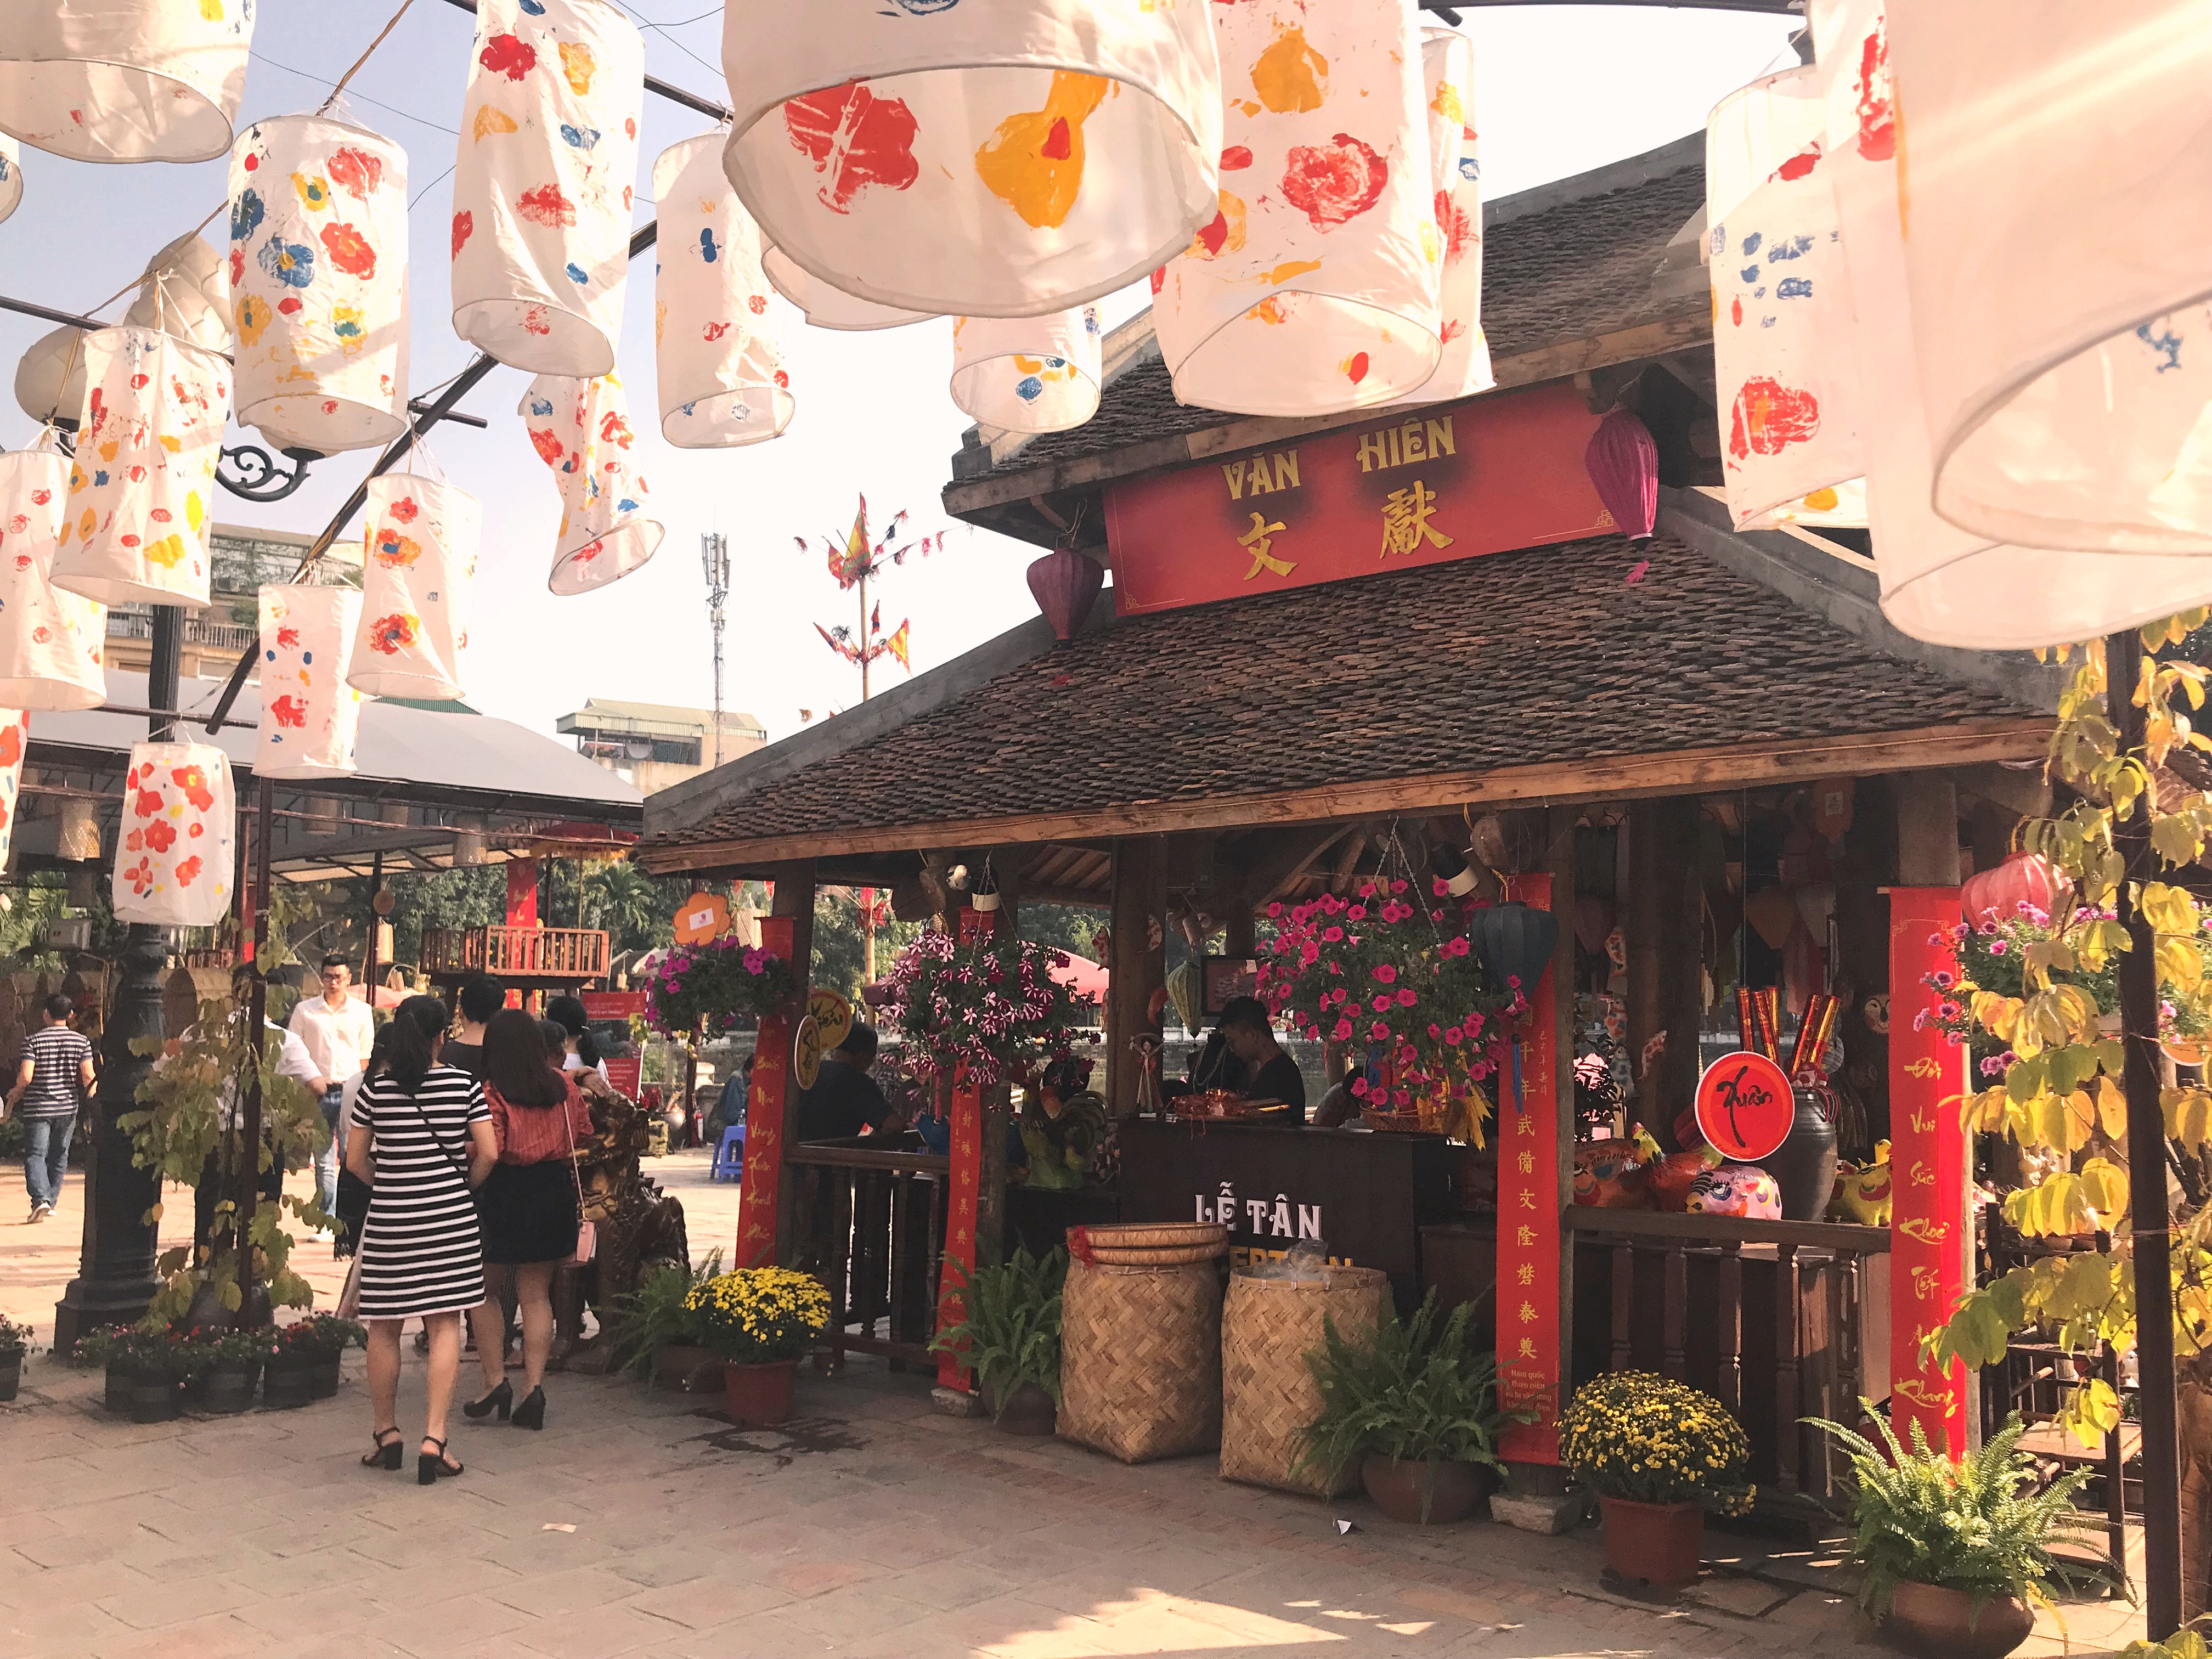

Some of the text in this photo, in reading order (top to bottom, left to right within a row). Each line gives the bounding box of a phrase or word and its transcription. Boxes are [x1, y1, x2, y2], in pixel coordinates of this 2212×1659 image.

[1221, 450, 1301, 500] VĂN
[1237, 512, 1299, 581] 文
[1716, 1065, 1773, 1148] Xuân
[1910, 1105, 1936, 1133] Vui
[1246, 1193, 1323, 1241] TÂN
[1910, 1266, 1941, 1300] Tết
[1894, 1378, 1959, 1418] Khang
